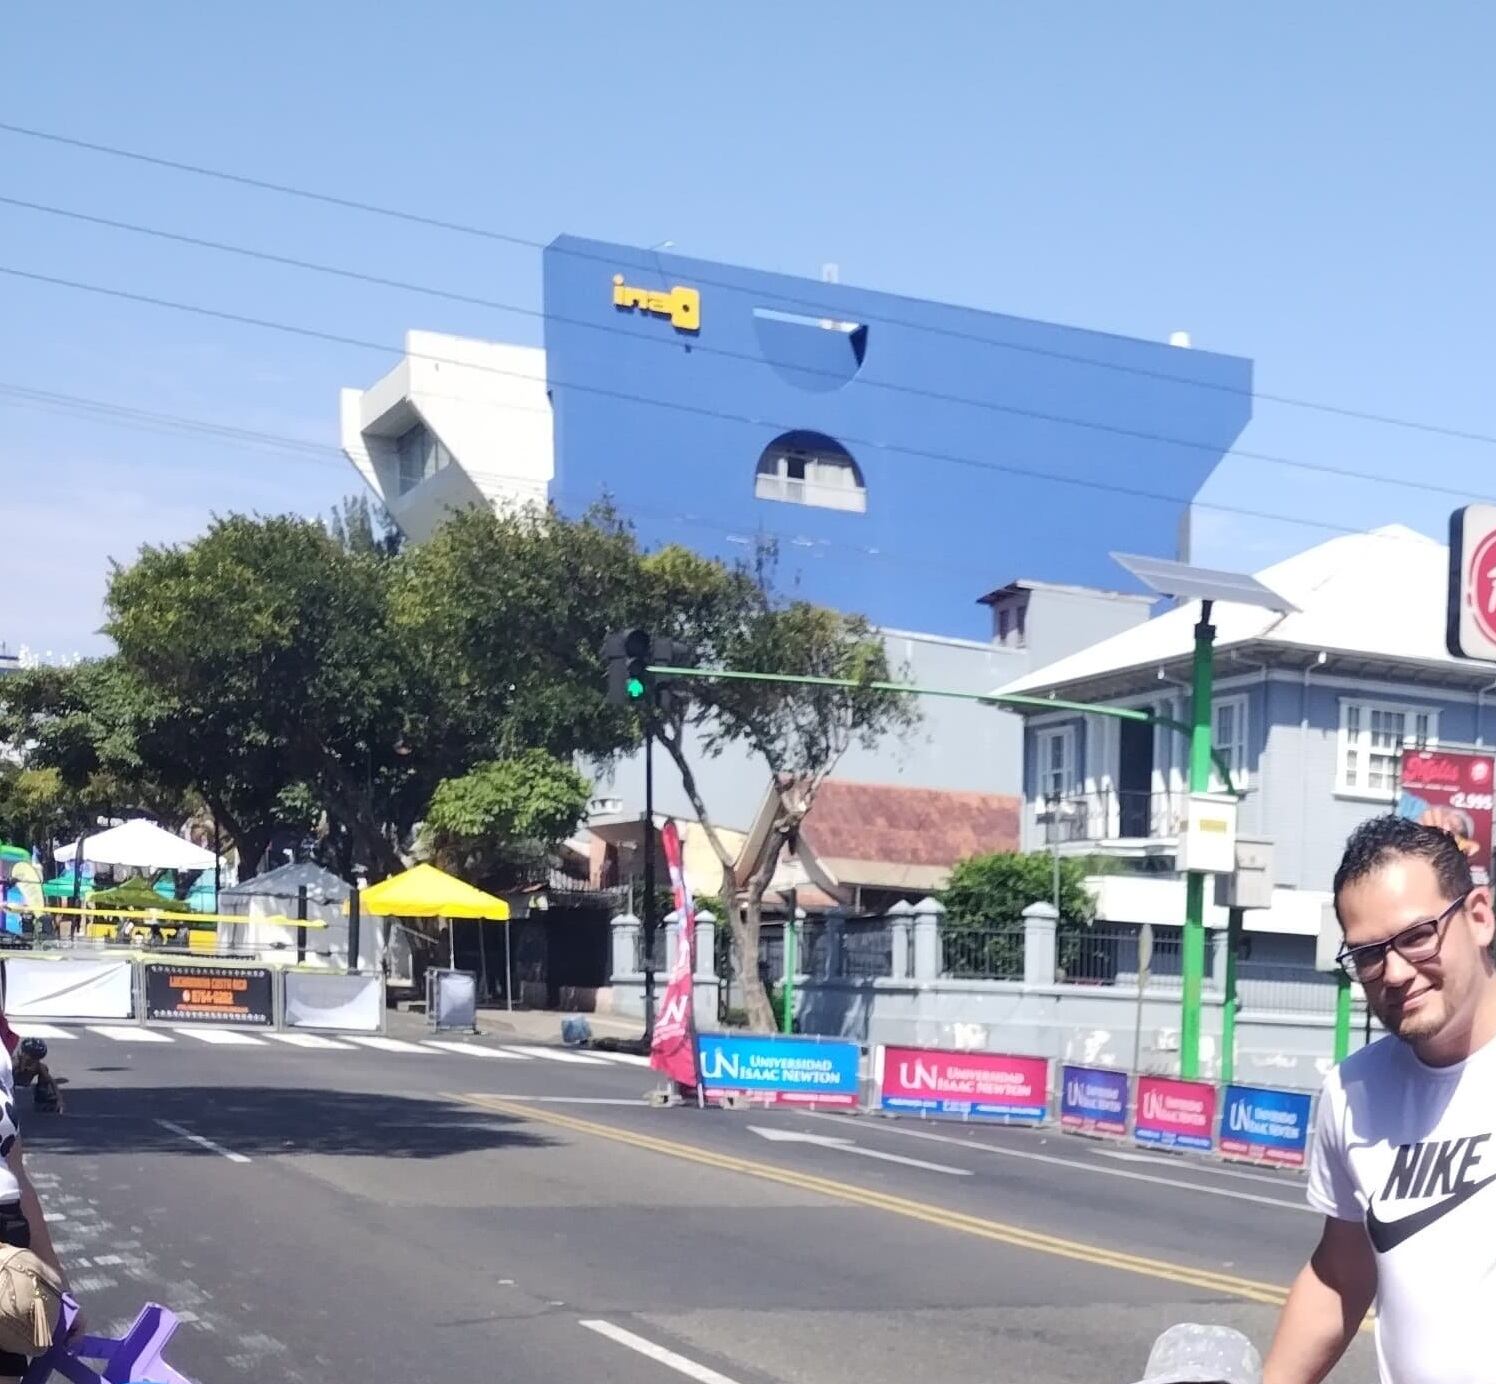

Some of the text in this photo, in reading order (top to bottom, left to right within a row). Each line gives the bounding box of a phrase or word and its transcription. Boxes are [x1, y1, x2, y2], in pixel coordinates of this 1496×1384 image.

[700, 1050, 740, 1079] UN
[739, 1066, 842, 1085] ISAAC NEWTON
[749, 1054, 833, 1072] UNIVERSIDAD
[899, 1061, 938, 1091] UN
[1379, 1132, 1493, 1202] NIKE
